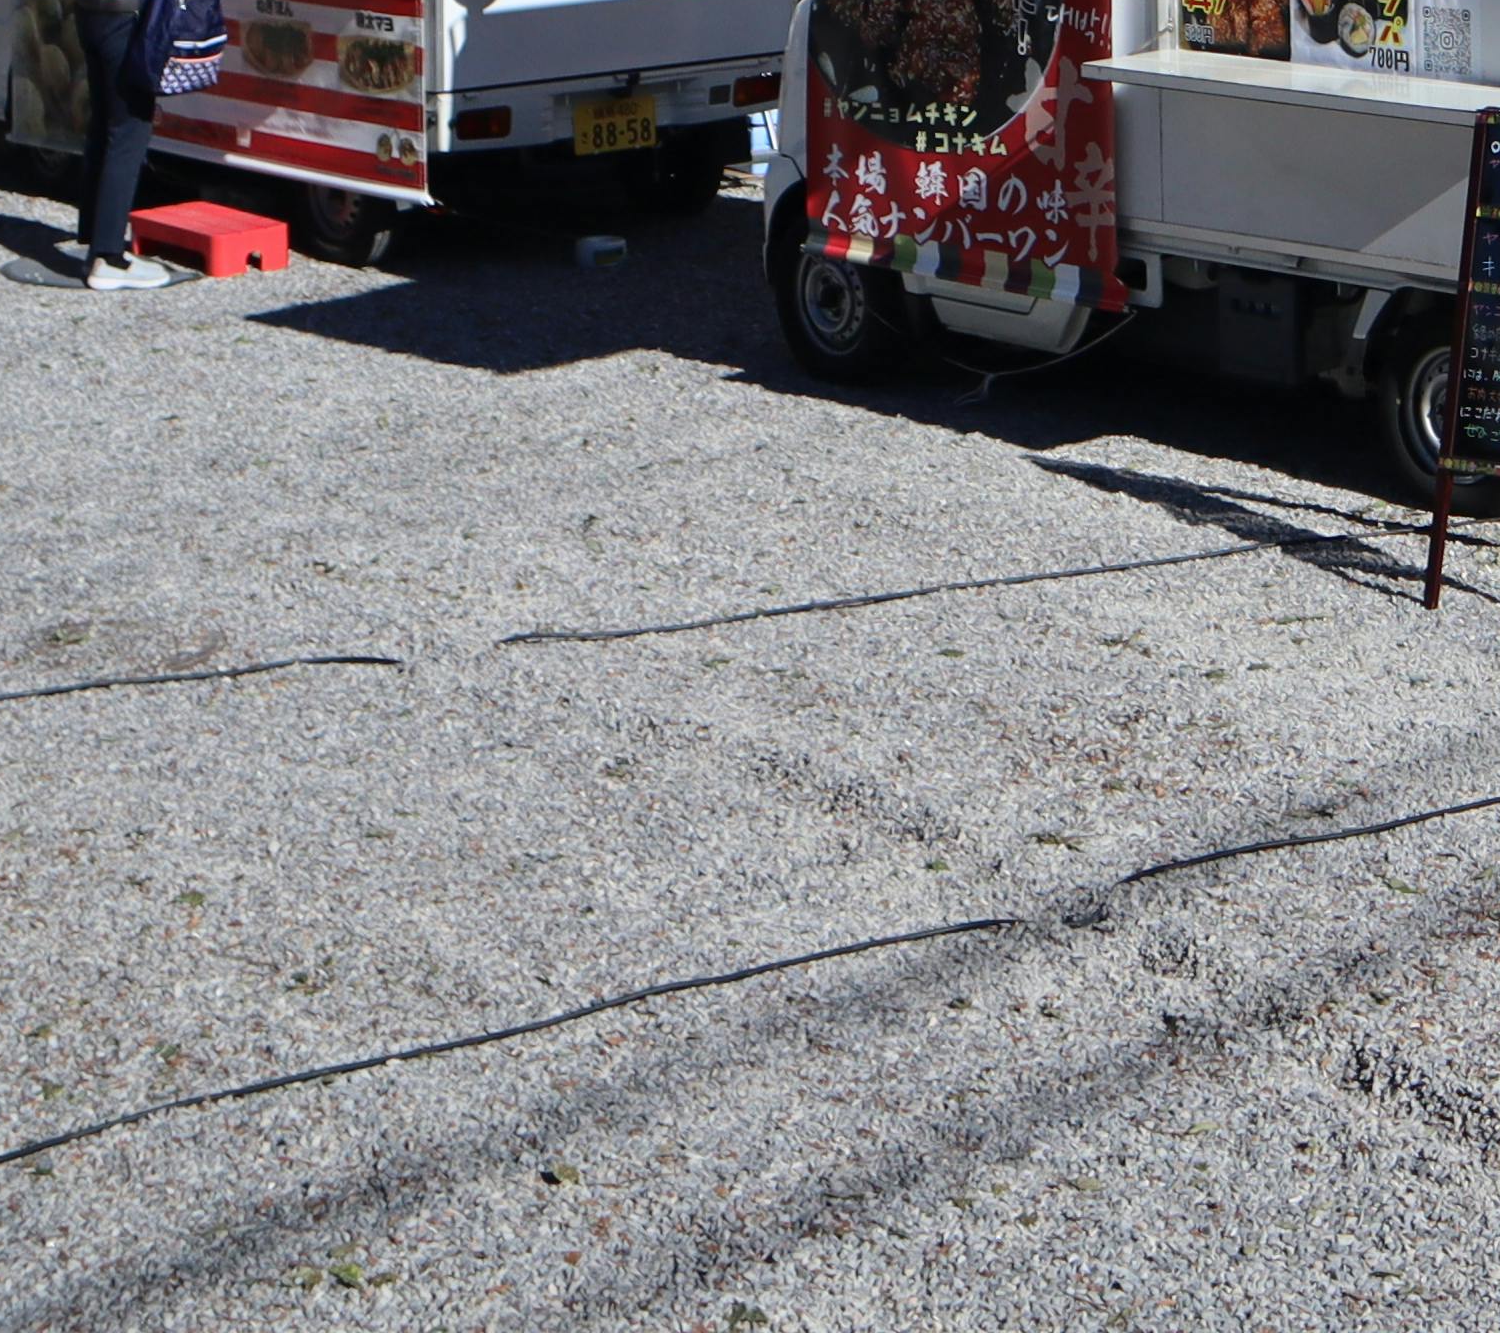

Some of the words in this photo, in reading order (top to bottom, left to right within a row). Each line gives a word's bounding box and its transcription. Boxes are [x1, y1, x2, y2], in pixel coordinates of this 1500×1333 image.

[1368, 46, 1410, 73] 700円
[592, 117, 652, 149] 88-58
[822, 143, 888, 195] 本場
[915, 160, 1069, 224] 韓国の味
[821, 190, 1069, 268] 人気ナンバーワン
